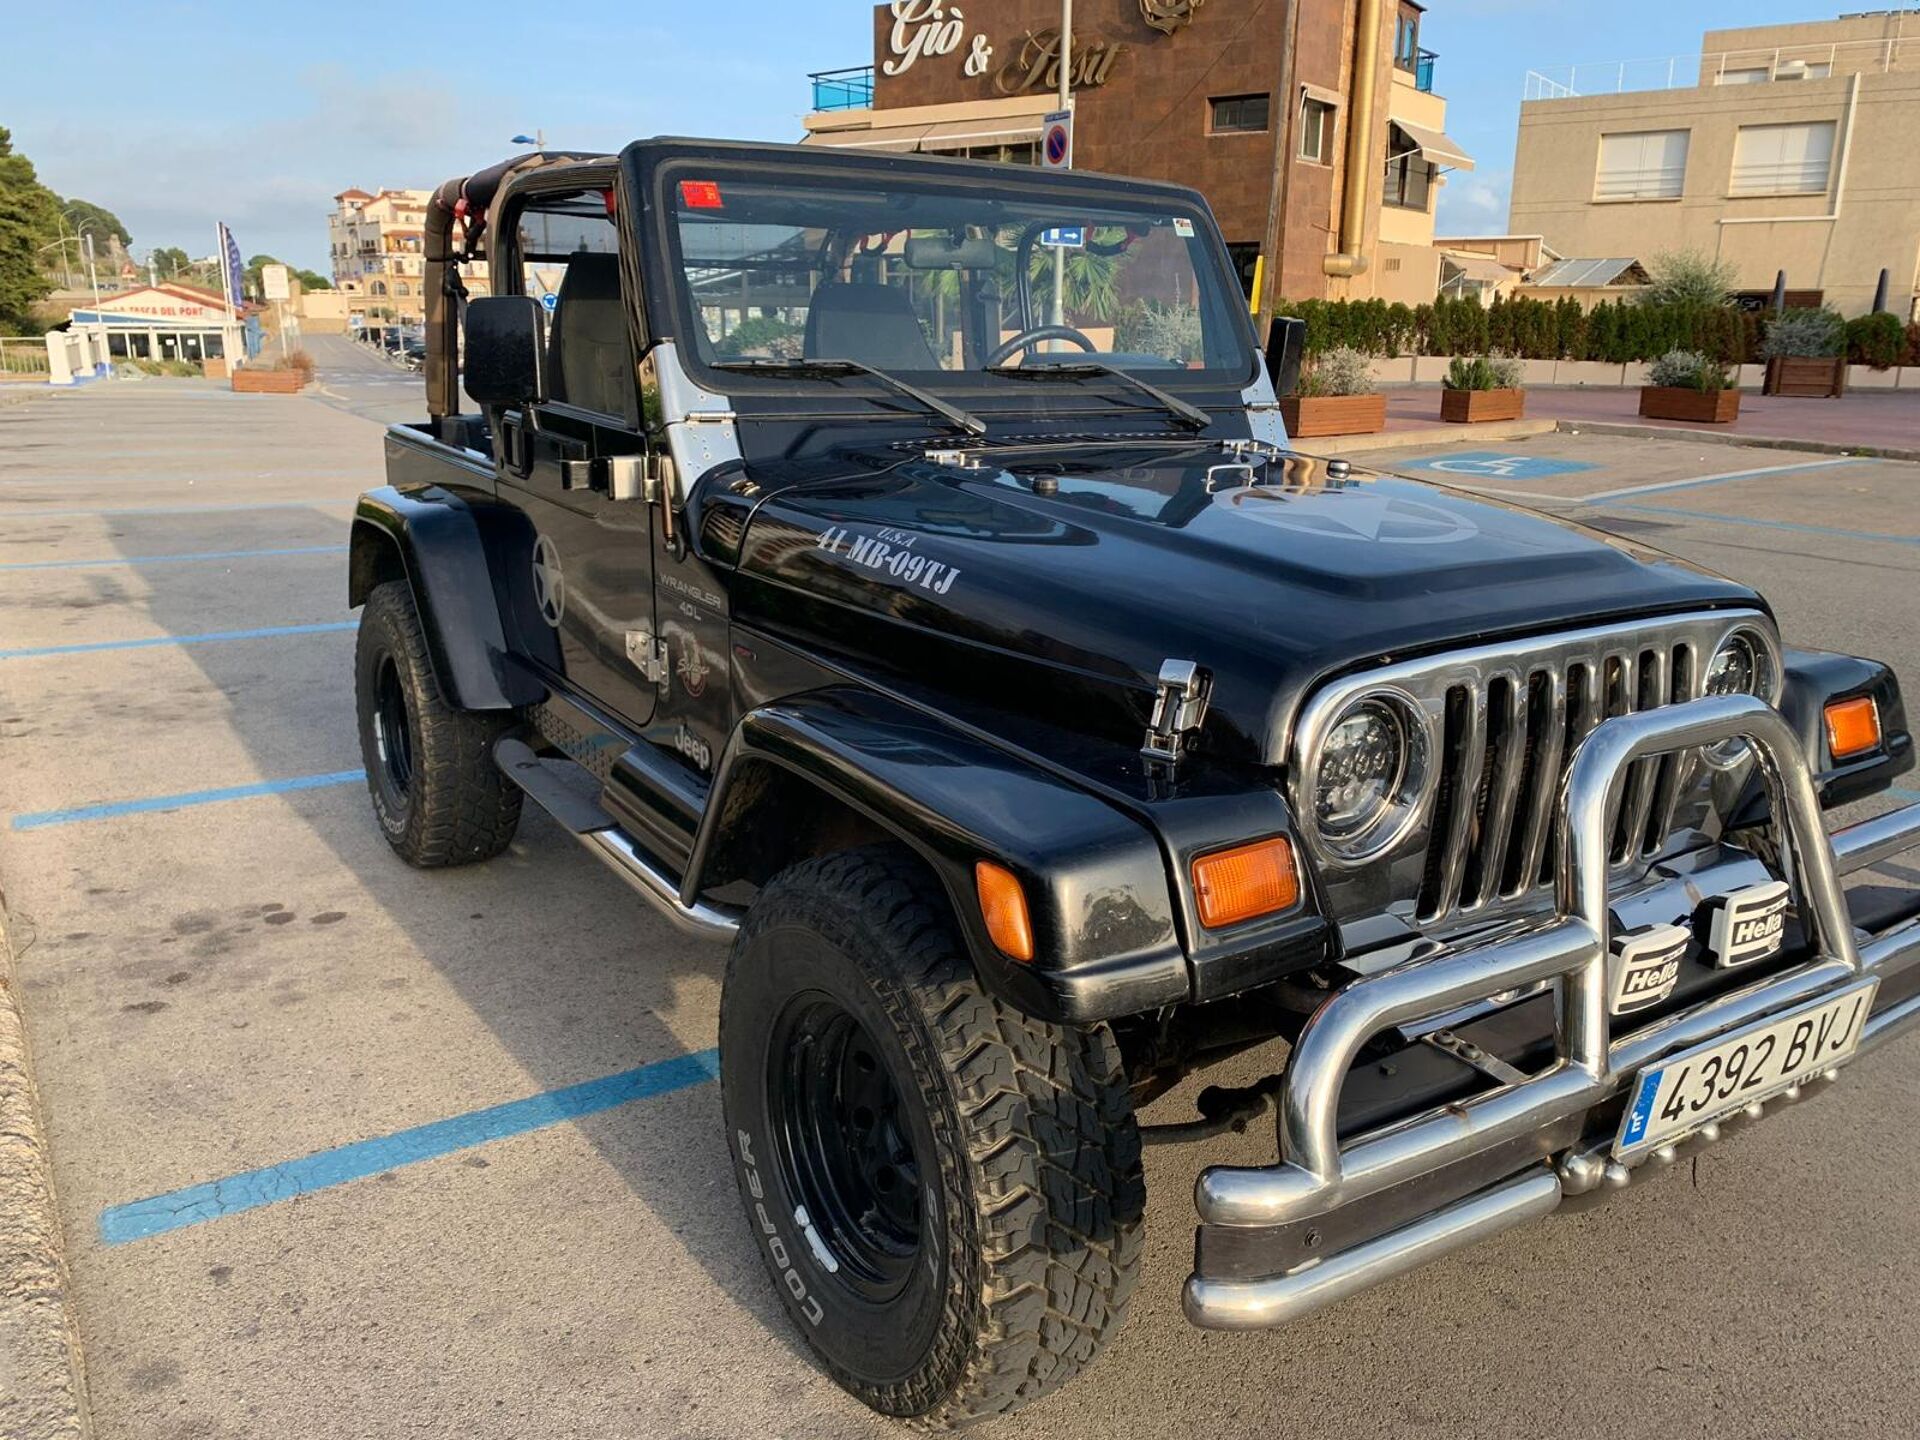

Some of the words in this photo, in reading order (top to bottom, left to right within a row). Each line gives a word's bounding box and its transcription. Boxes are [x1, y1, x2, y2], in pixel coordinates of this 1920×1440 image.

[883, 0, 964, 76] Giò
[964, 34, 993, 76] &
[160, 307, 177, 317] DEL
[179, 307, 204, 317] PORT
[815, 526, 847, 554] 41
[846, 535, 961, 595] MB-09TJ
[660, 574, 721, 609] WRANGLER
[674, 725, 710, 770] Jeep
[1735, 913, 1783, 944] Hella
[1626, 961, 1679, 993] Hella
[1660, 1034, 1776, 1121] 4392
[1781, 996, 1863, 1076] BVJ
[737, 1128, 824, 1327] COOPER
